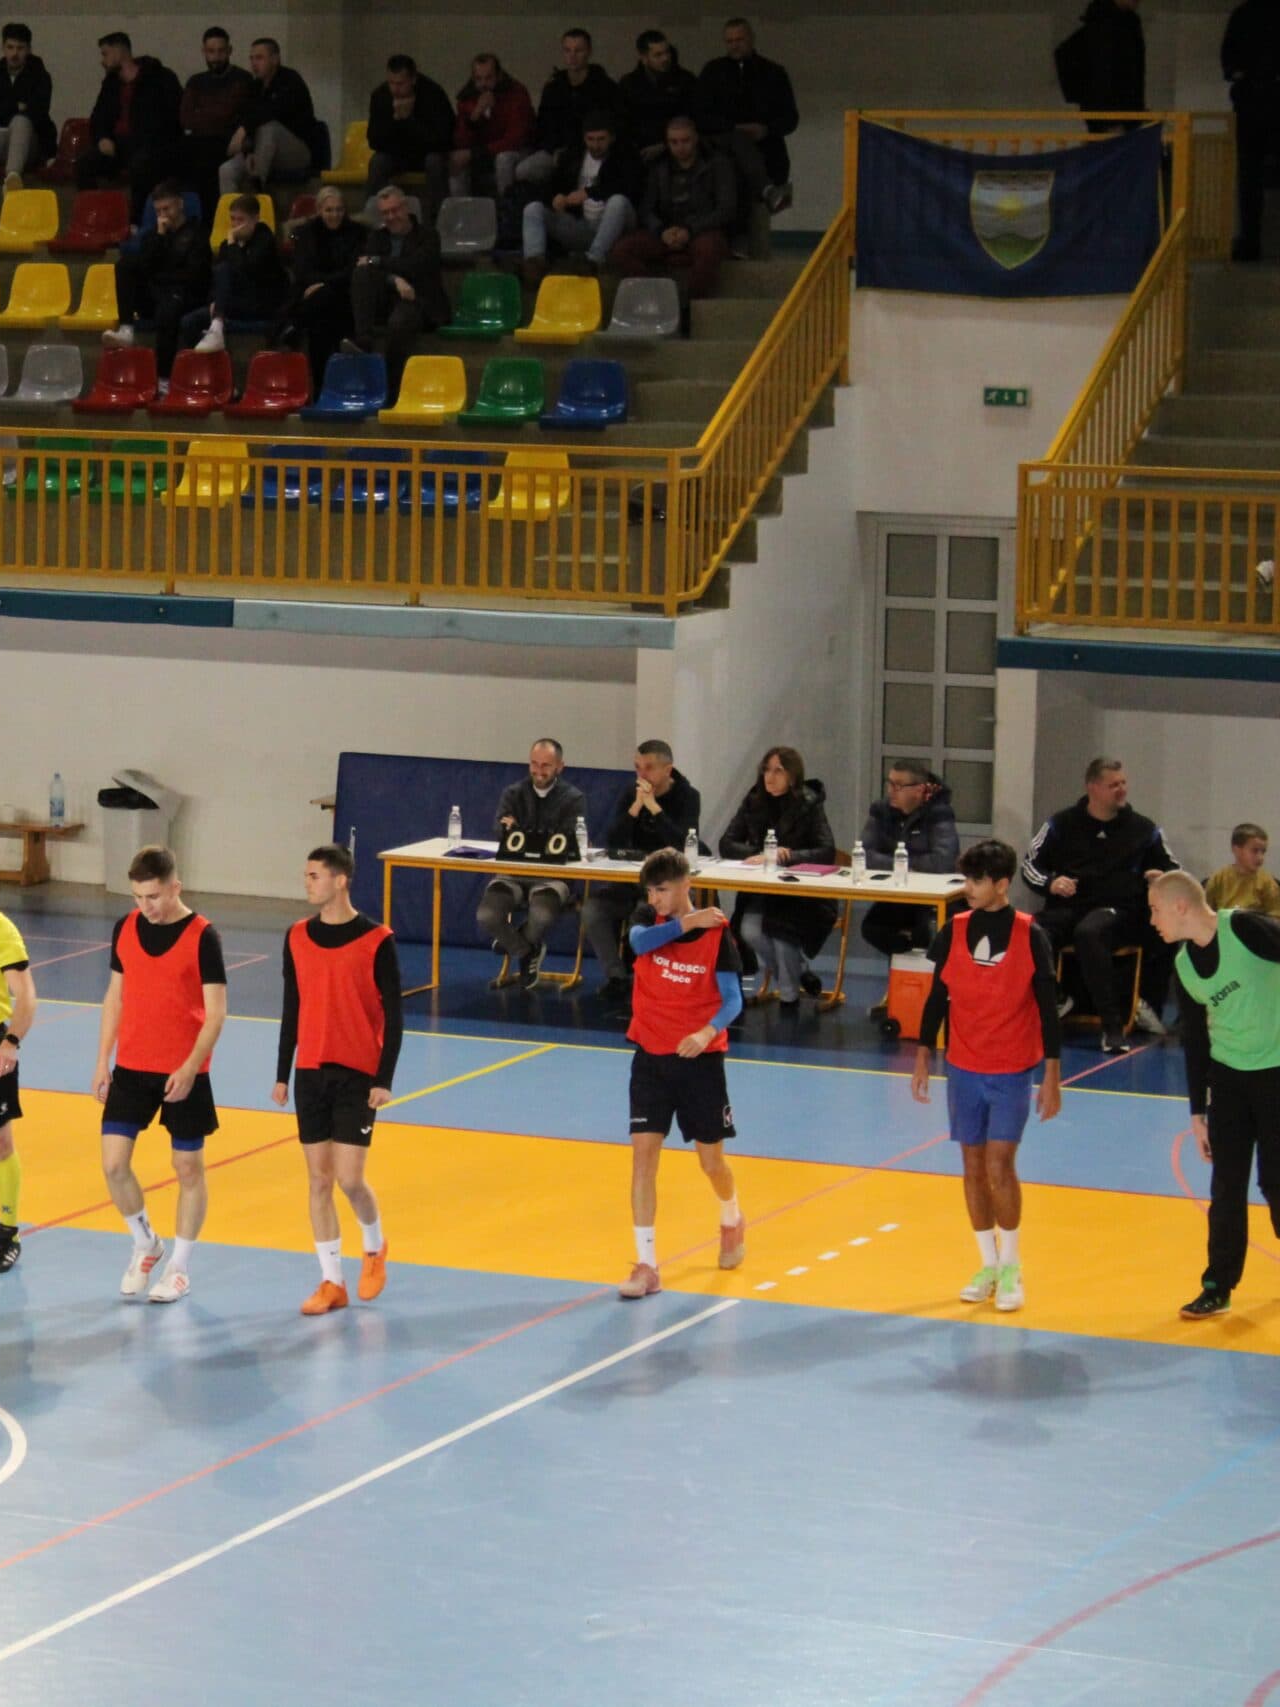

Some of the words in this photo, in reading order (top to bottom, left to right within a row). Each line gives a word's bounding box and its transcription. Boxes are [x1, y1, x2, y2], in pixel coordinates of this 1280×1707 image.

[506, 831, 525, 852] 0
[548, 833, 567, 855] 0
[672, 962, 706, 974] BOSCO
